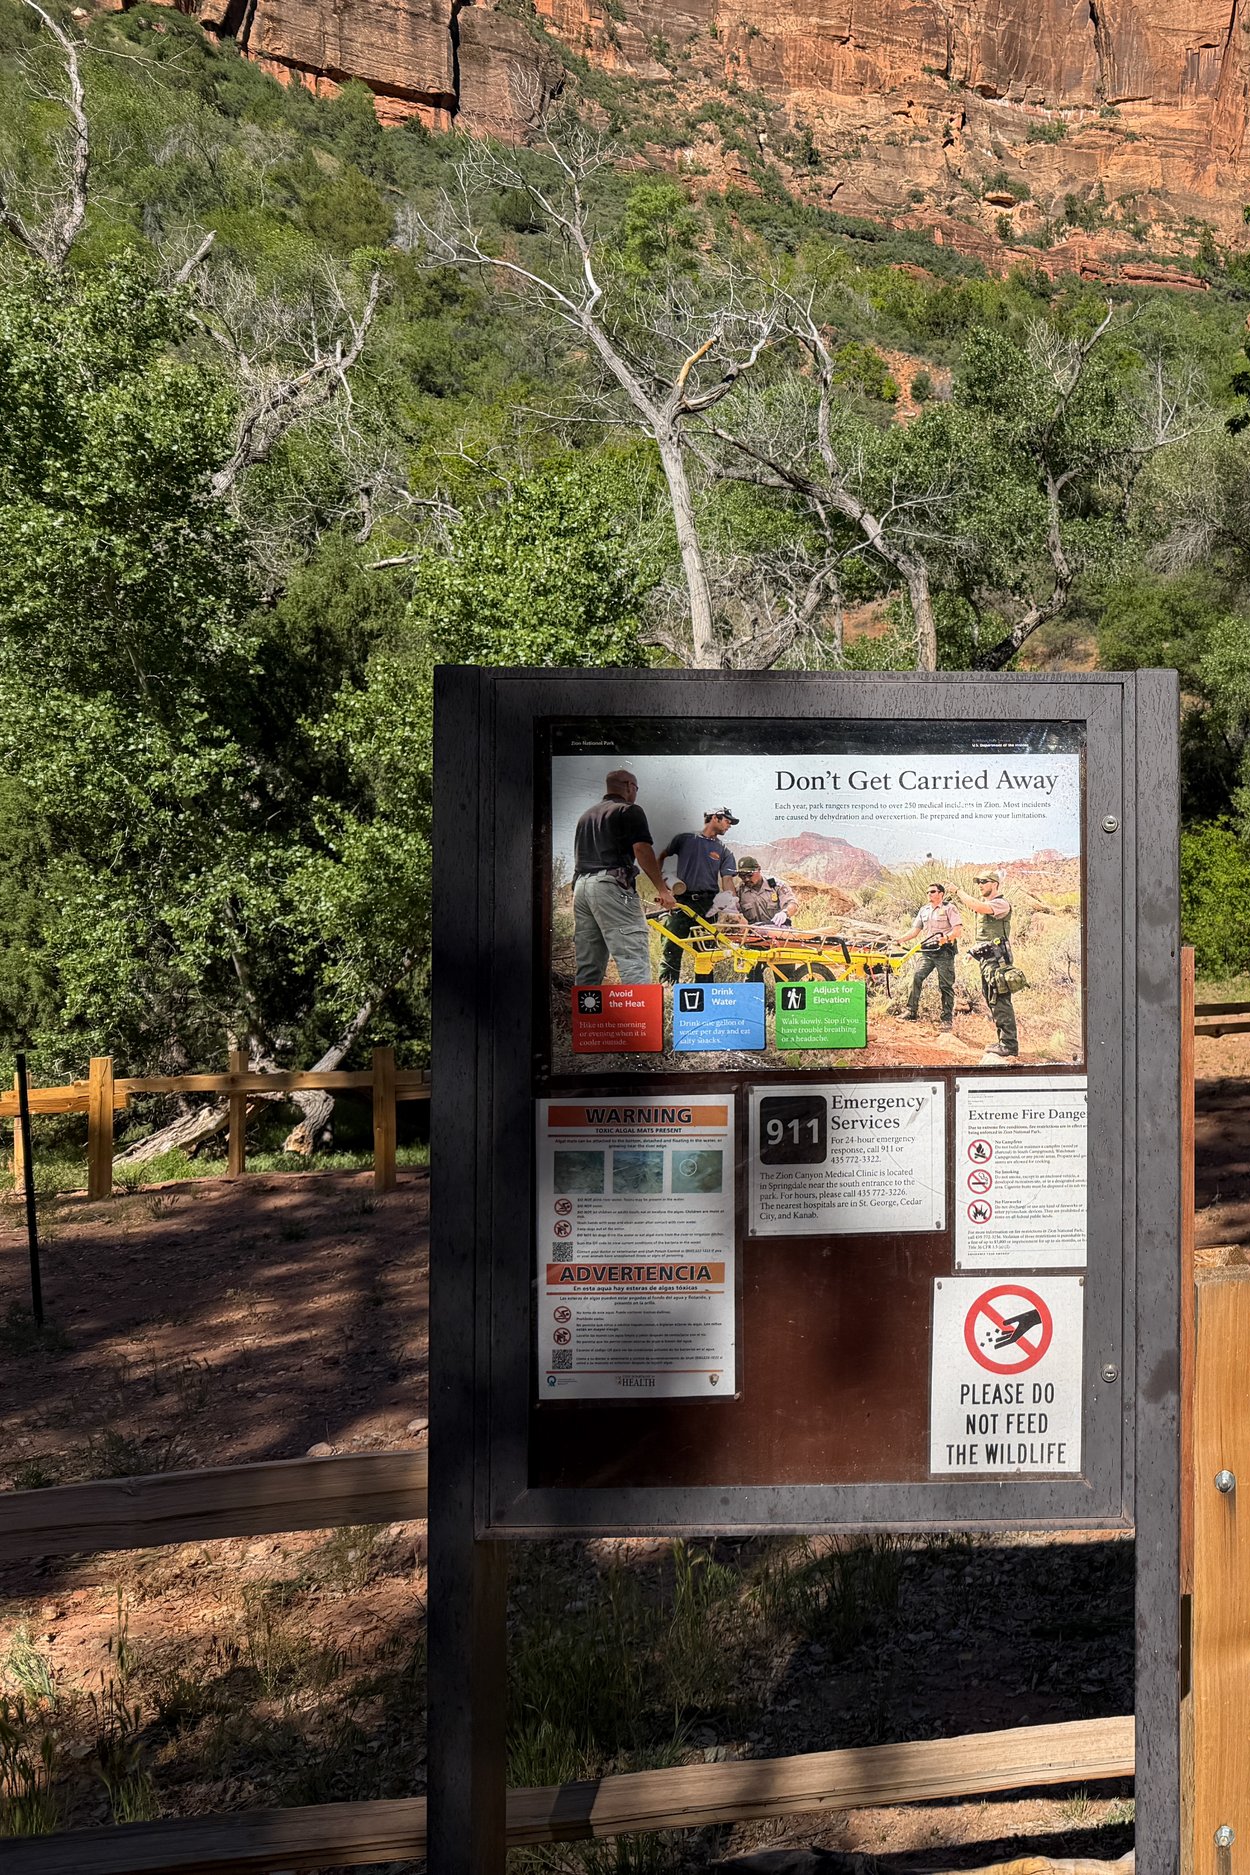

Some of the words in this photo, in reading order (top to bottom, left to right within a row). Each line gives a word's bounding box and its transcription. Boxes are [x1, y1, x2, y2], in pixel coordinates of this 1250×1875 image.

[775, 770, 841, 791] Don't
[848, 770, 891, 791] Get
[899, 770, 988, 791] Carried
[996, 770, 1058, 795] Away
[809, 813, 818, 822] by
[819, 813, 860, 823] dehydration
[929, 812, 960, 821] prepared
[609, 989, 633, 997] Avoid
[711, 987, 734, 995] Drink
[813, 985, 840, 997] Adjust
[841, 985, 854, 993] for
[813, 996, 850, 1004] Elevation
[831, 1094, 924, 1114] Emergency
[585, 1107, 691, 1125] WARNING
[969, 1110, 1018, 1120] Extreme
[1022, 1110, 1045, 1119] Fire
[1049, 1109, 1088, 1122] Dange
[831, 1115, 900, 1131] Services
[766, 1118, 819, 1146] 911
[831, 1136, 844, 1145] For
[845, 1136, 875, 1144] 24-hour
[876, 1136, 915, 1145] emergency
[830, 1147, 866, 1156] response,
[866, 1145, 880, 1153] call
[880, 1145, 893, 1153] 911
[830, 1156, 844, 1164] 435
[845, 1156, 881, 1164] 772-3322.
[759, 1172, 775, 1180] The
[775, 1171, 793, 1180] Zion
[794, 1171, 823, 1180] Canyon
[824, 1170, 855, 1178] Medical
[855, 1169, 878, 1177] Clinic
[879, 1169, 885, 1177] is
[887, 1168, 913, 1176] located
[759, 1182, 767, 1190] in
[768, 1181, 807, 1192] Springdale
[826, 1180, 838, 1188] the
[839, 1180, 860, 1188] south
[903, 1178, 915, 1186] the
[759, 1192, 778, 1202] park.
[794, 1191, 818, 1200] hours,
[819, 1190, 842, 1200] please
[843, 1190, 856, 1198] call
[857, 1189, 871, 1197] 435
[872, 1188, 907, 1197] 772-3226.
[559, 1265, 711, 1283] ADVERTENCIA
[622, 1378, 655, 1387] HEALTH
[960, 1383, 1024, 1405] PLEASE
[1032, 1382, 1054, 1404] DO
[966, 1413, 999, 1435] NOT
[1006, 1413, 1048, 1434] FEED
[946, 1444, 978, 1465] THE
[985, 1443, 1066, 1465] WILDLIFE
